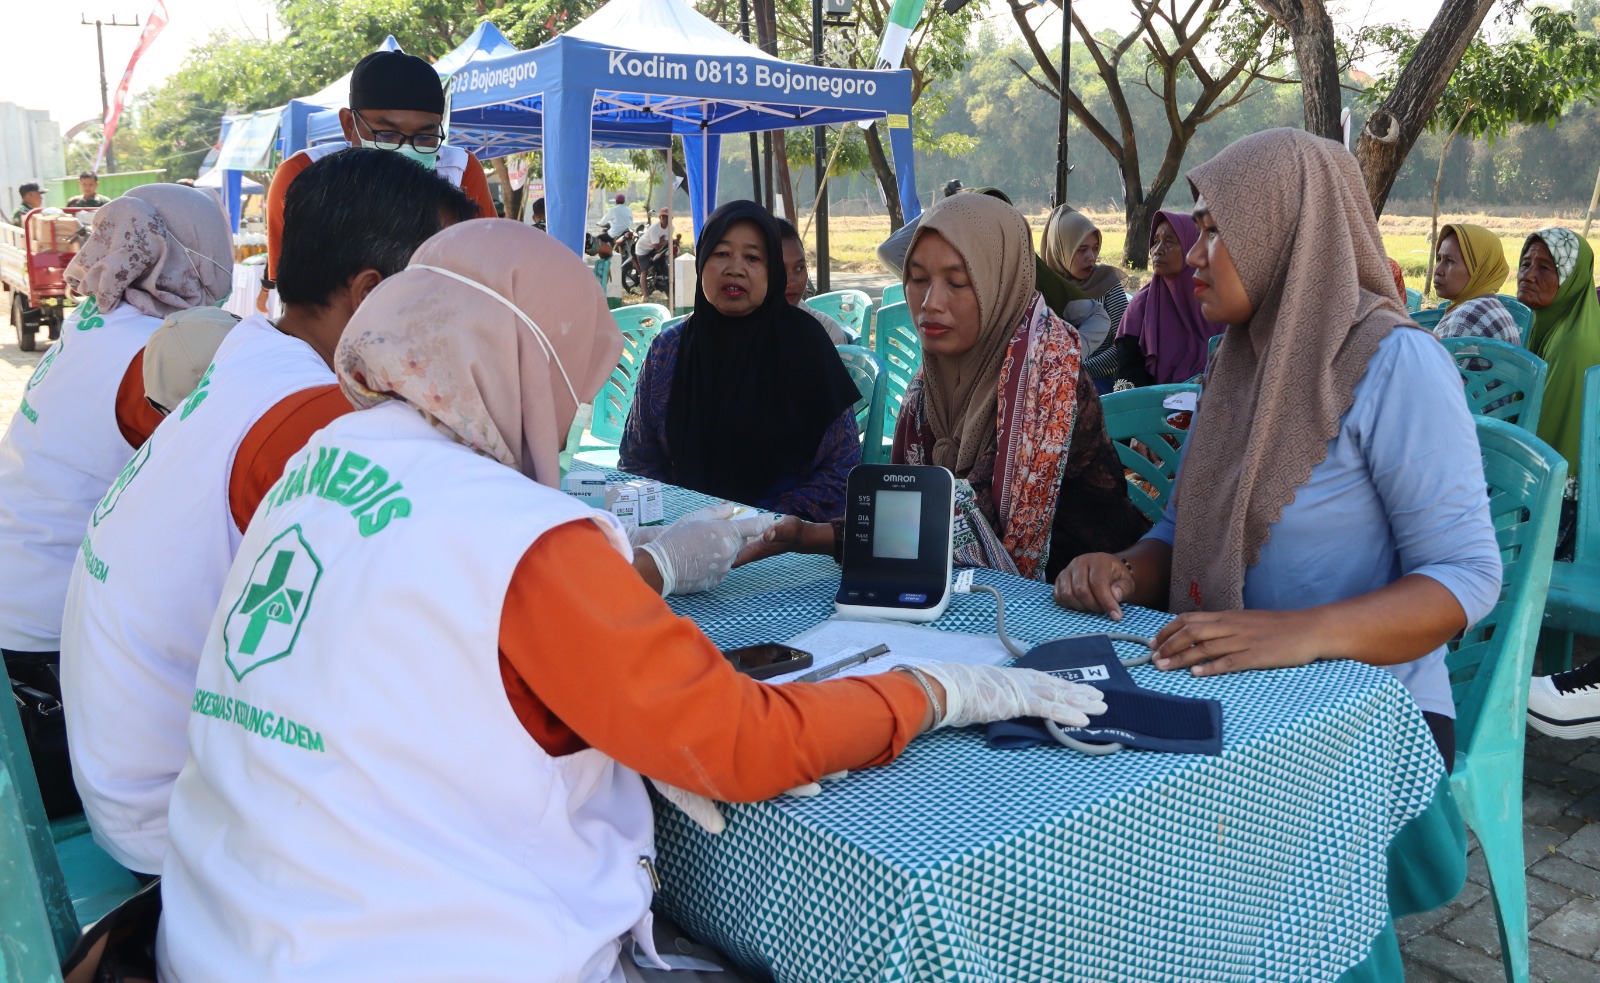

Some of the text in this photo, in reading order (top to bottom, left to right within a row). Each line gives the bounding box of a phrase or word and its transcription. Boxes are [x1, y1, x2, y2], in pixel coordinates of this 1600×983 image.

[470, 61, 537, 94] Bojonegoro
[608, 50, 877, 98] Kodim 0813 Bojonegoro
[306, 446, 412, 538] MEDIS
[883, 474, 916, 483] OMRON
